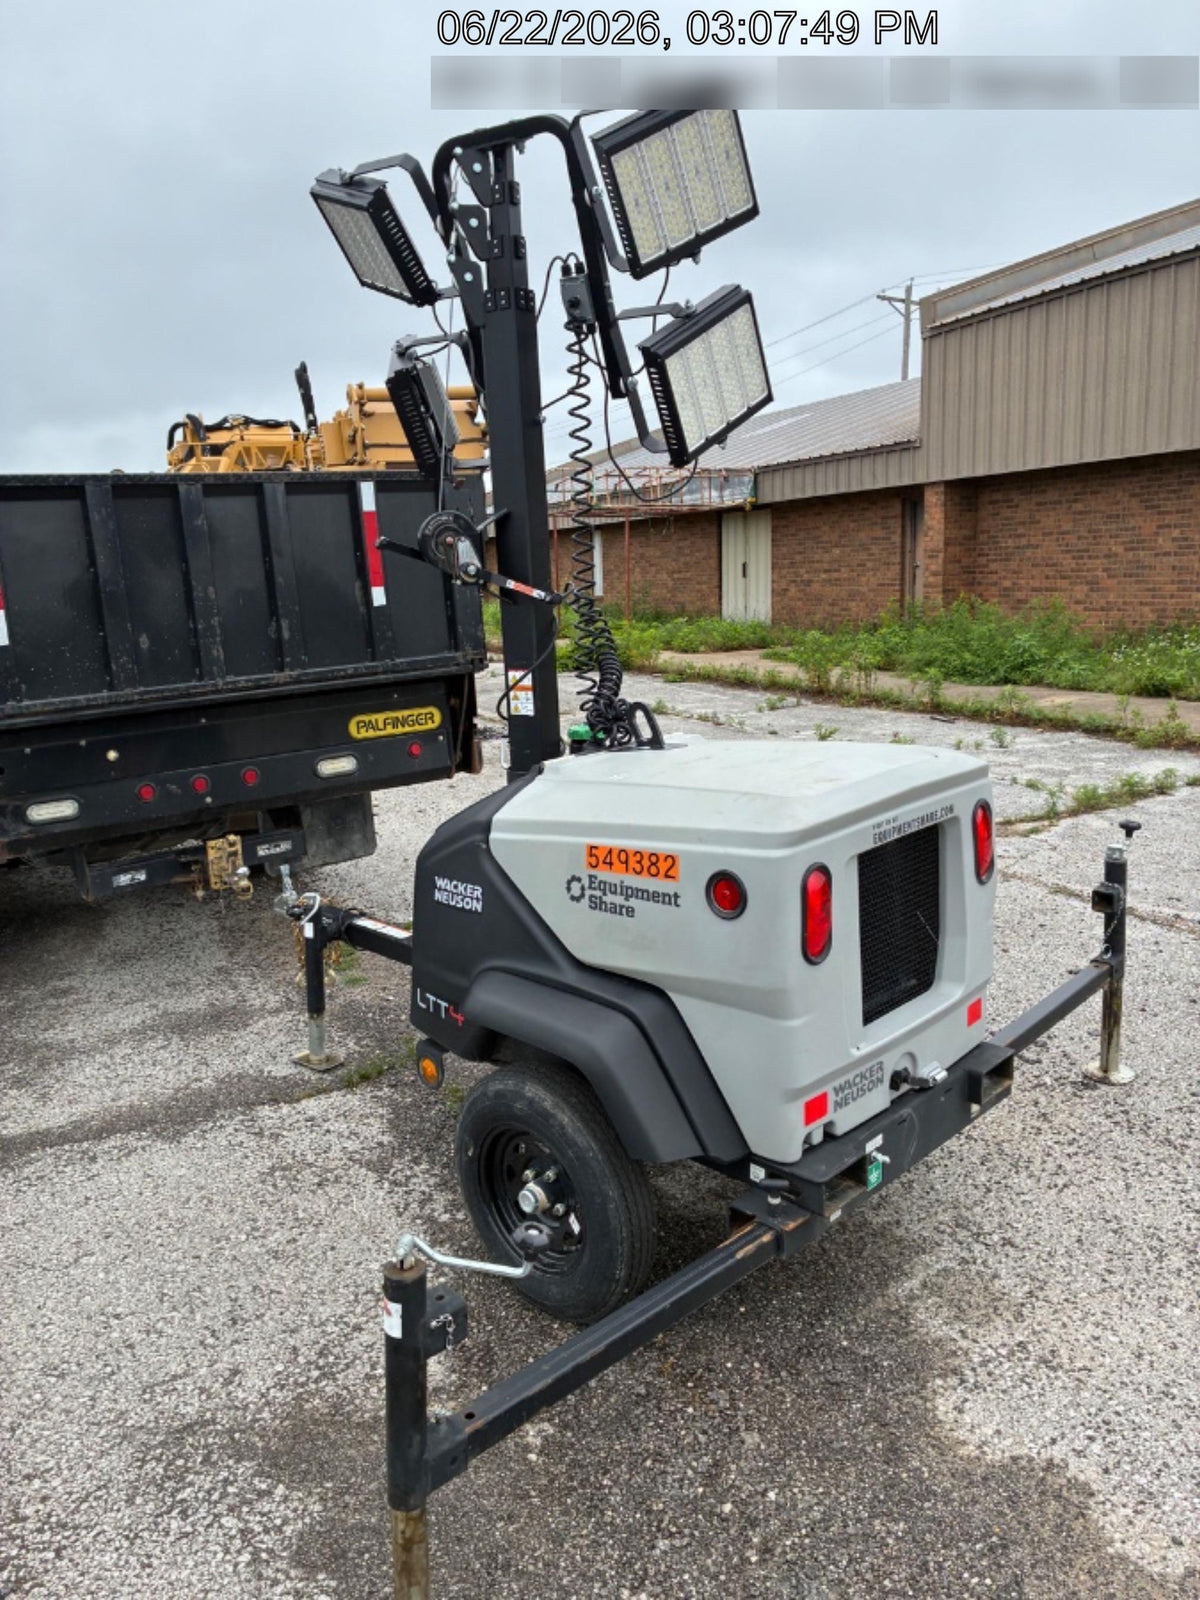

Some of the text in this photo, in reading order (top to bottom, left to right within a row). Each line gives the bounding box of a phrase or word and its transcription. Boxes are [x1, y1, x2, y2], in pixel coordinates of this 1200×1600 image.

[355, 712, 435, 734] PALFINGER
[588, 845, 677, 880] 549382
[434, 875, 483, 900] WACKER
[434, 888, 483, 913] NEUSON
[587, 874, 681, 907] Equipment
[588, 894, 635, 918] Share
[417, 987, 465, 1027] LTT4
[832, 1061, 884, 1097] WACKER
[833, 1074, 884, 1113] NEUSON
